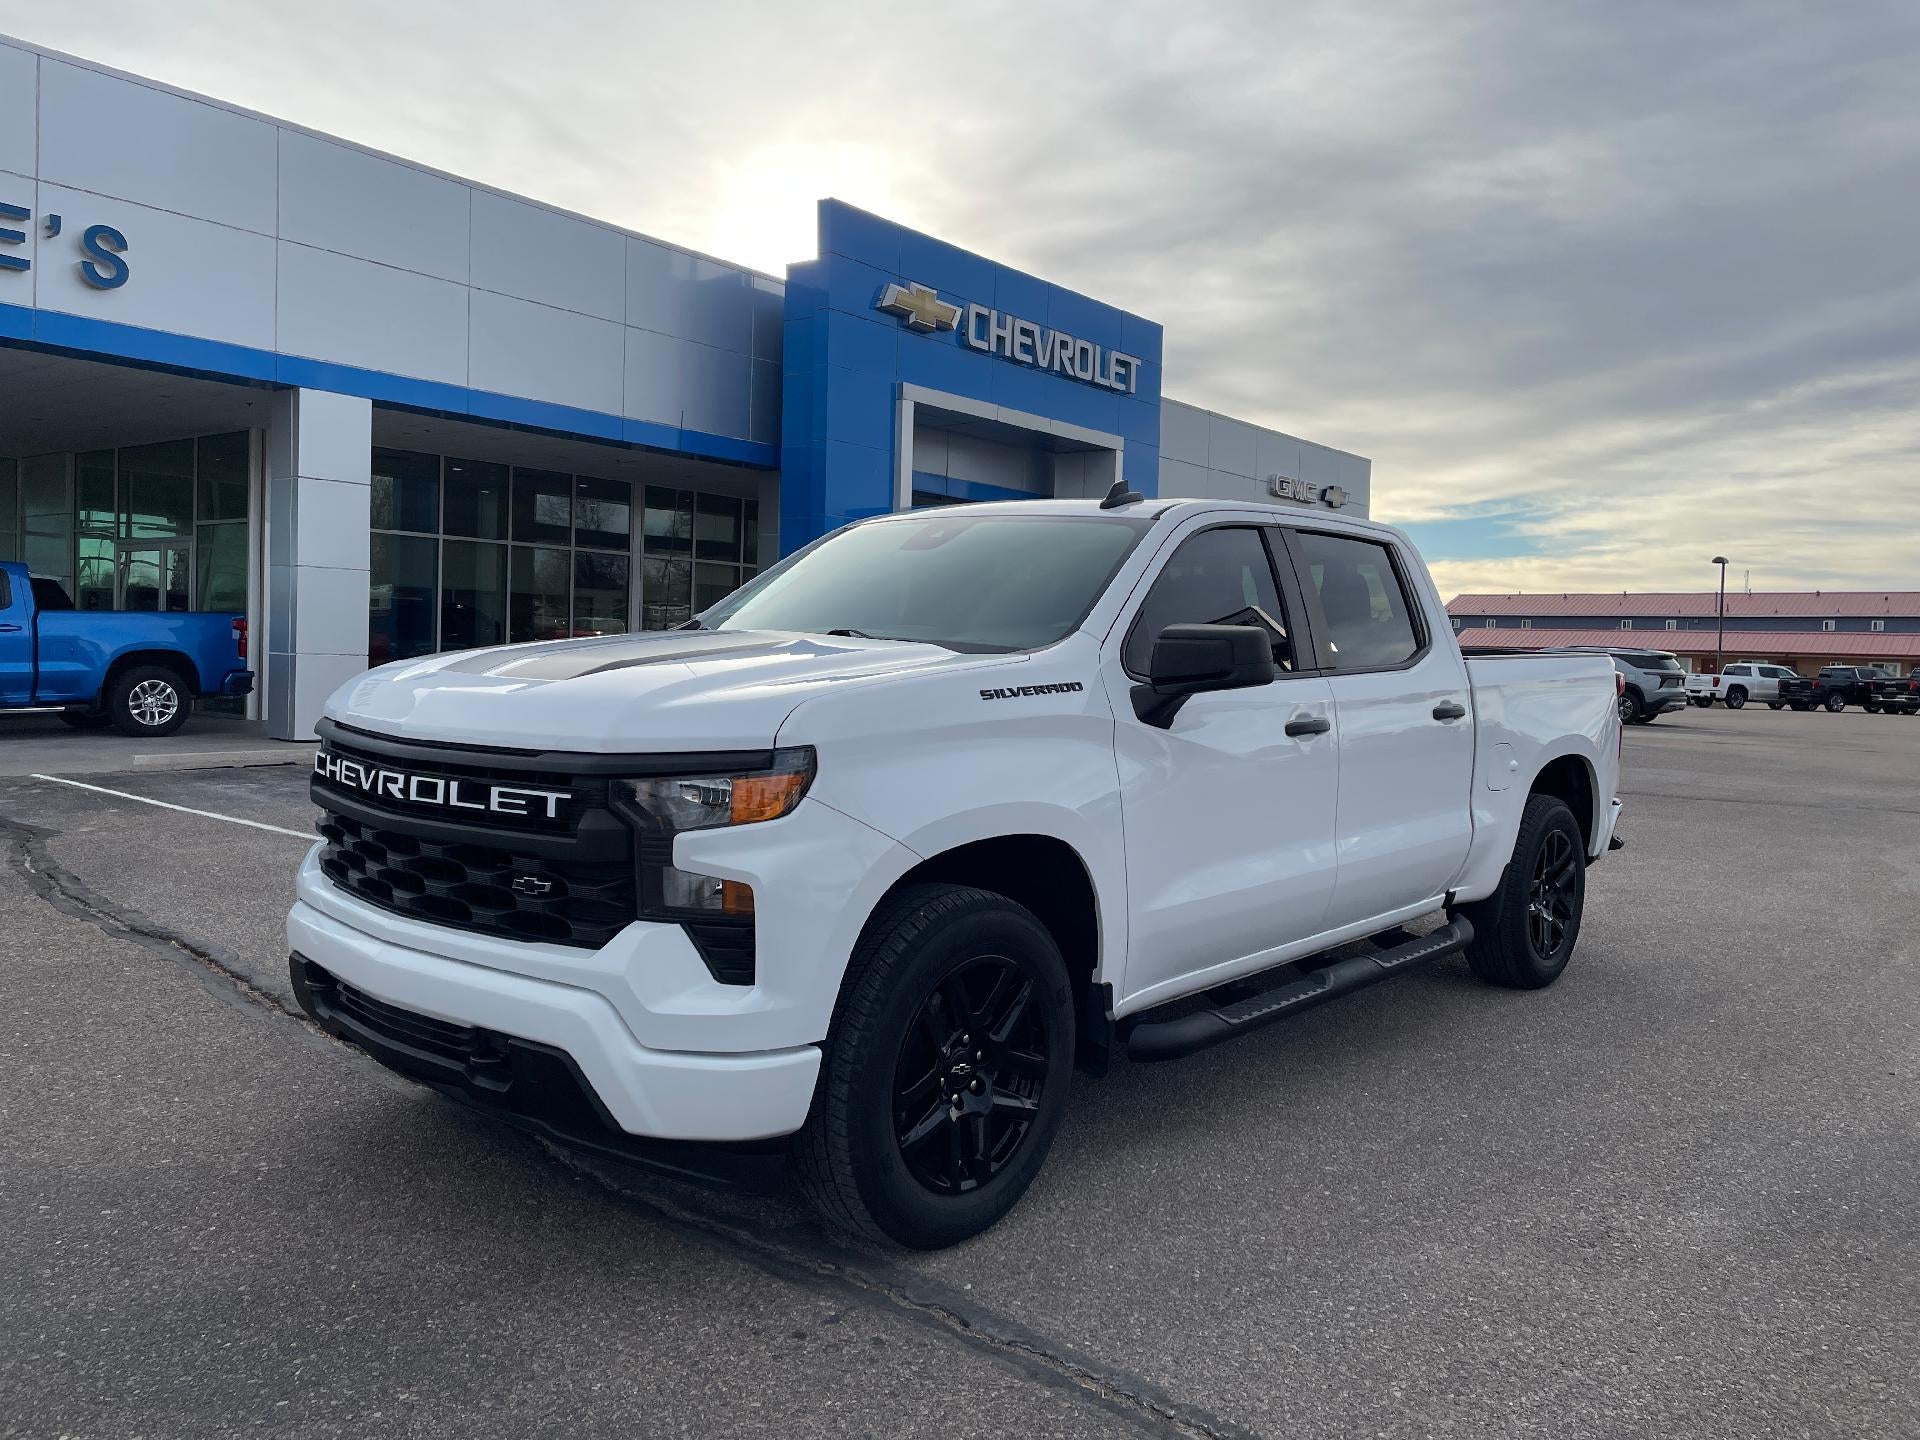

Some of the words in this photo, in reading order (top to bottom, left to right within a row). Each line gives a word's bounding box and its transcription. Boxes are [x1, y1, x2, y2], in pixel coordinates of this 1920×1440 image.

[968, 303, 1142, 394] CHEVROLET
[1273, 474, 1317, 503] GMC
[980, 682, 1083, 700] SILVERADO
[314, 751, 572, 818] CHEVROLET
